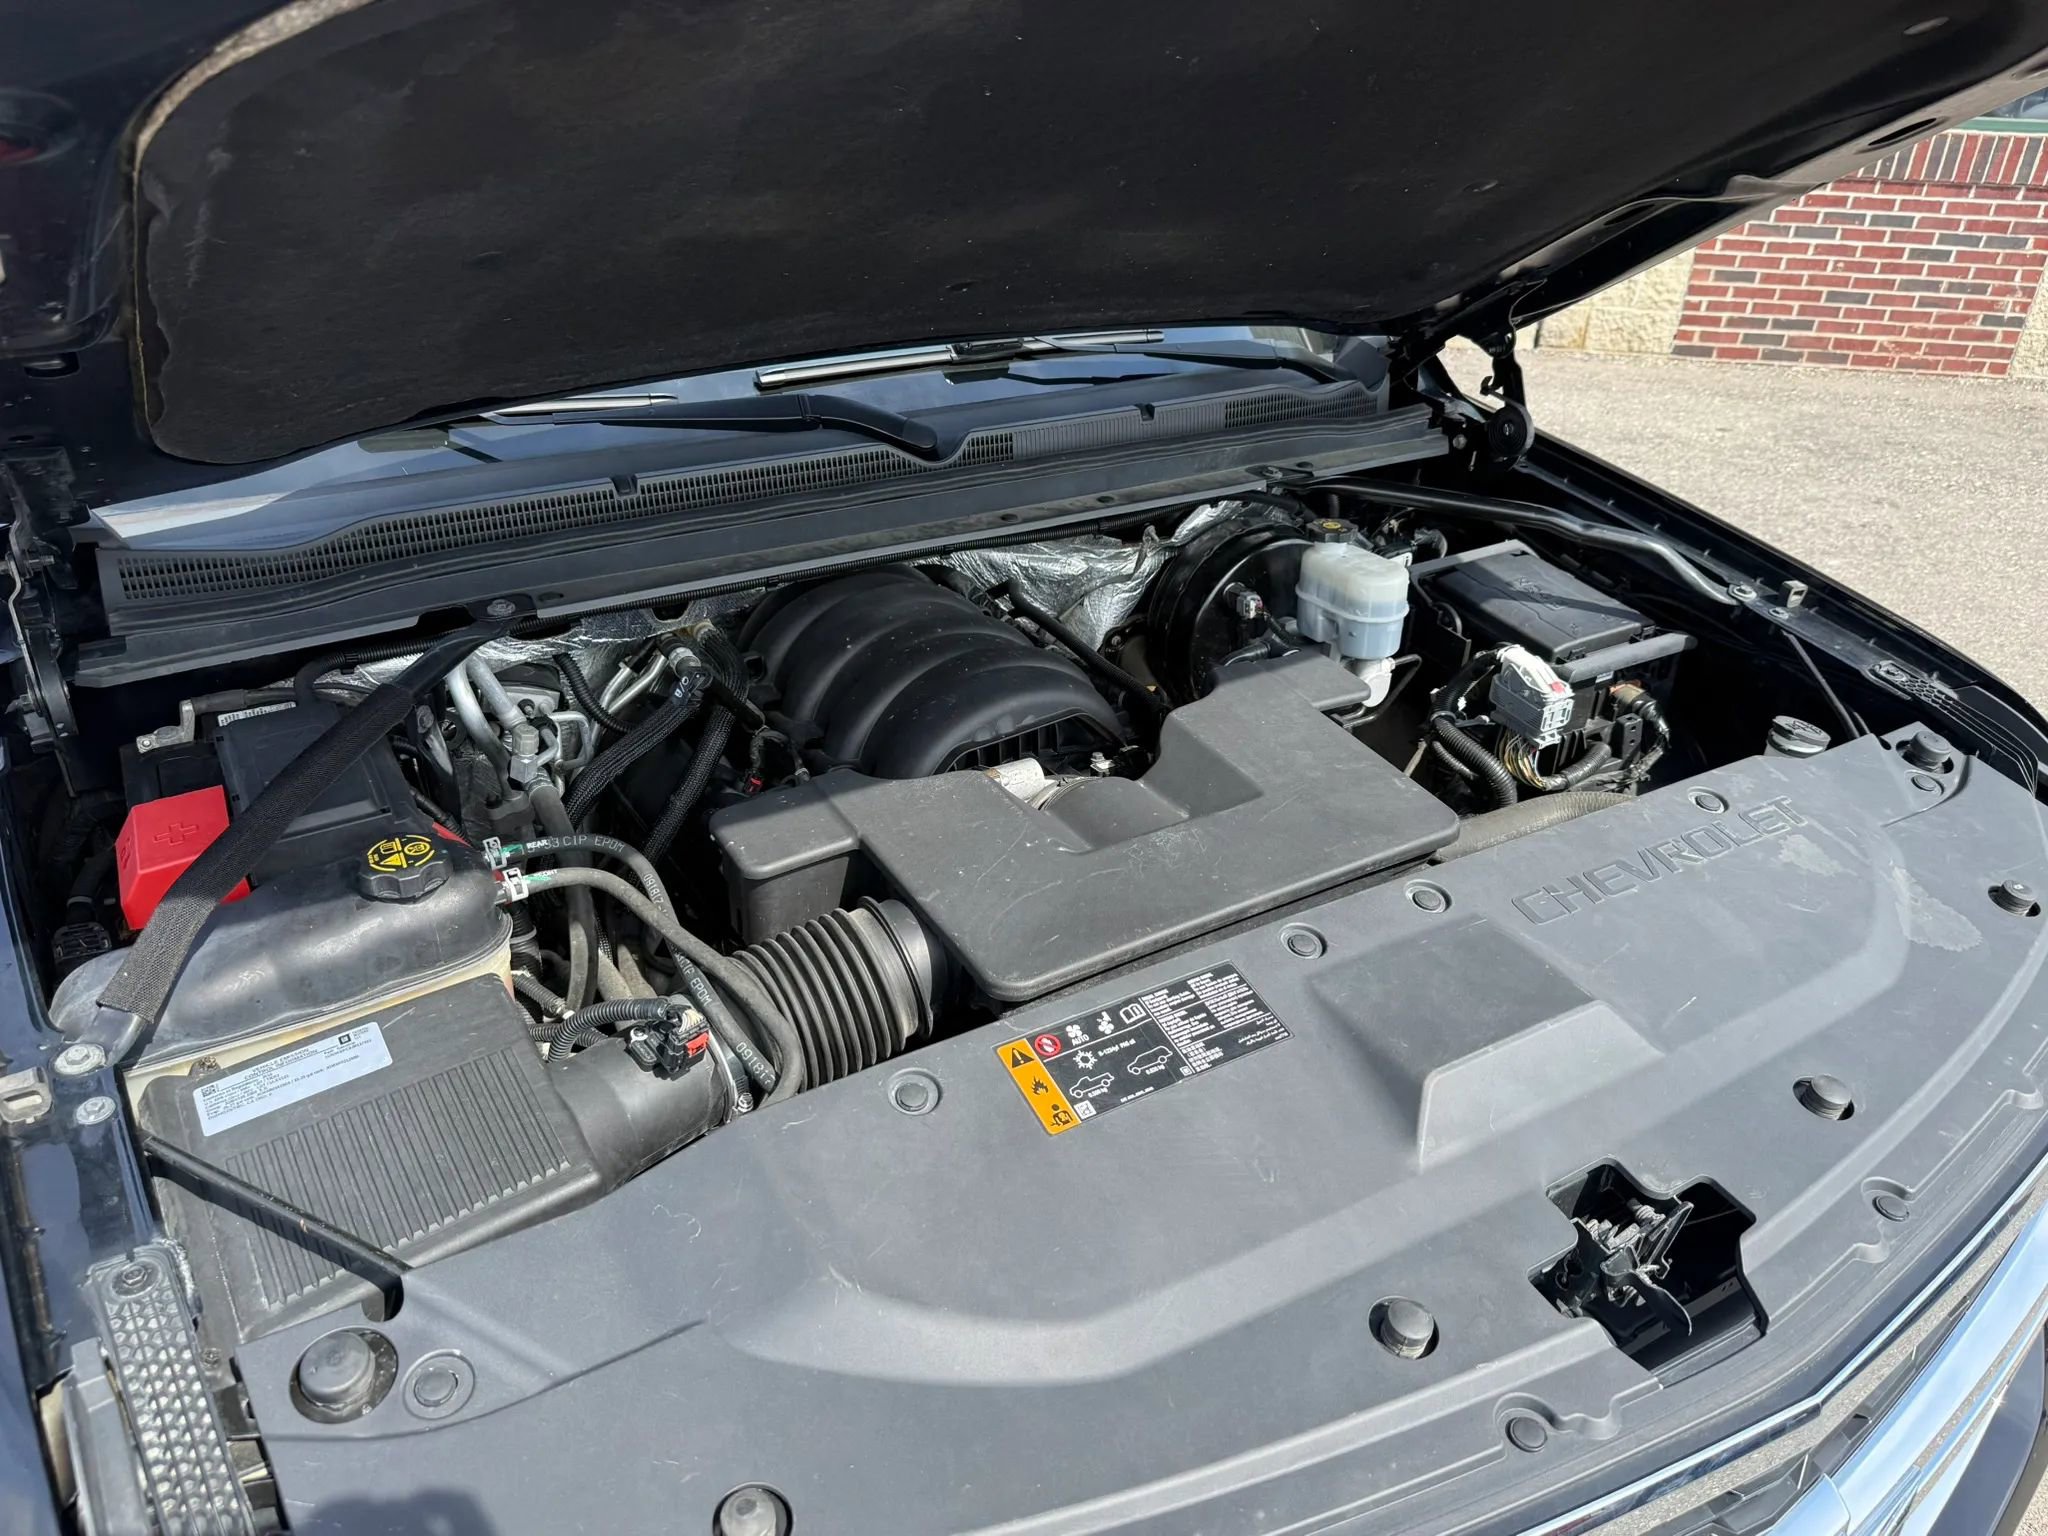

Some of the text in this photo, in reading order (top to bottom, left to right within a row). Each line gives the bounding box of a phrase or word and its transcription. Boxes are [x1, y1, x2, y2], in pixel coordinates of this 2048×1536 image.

[525, 839, 547, 849] REAR
[1510, 794, 1809, 926] CHEVROLET
[642, 872, 664, 904] 091817
[1071, 1033, 1090, 1046] AUTO
[734, 1041, 776, 1084] 091817
